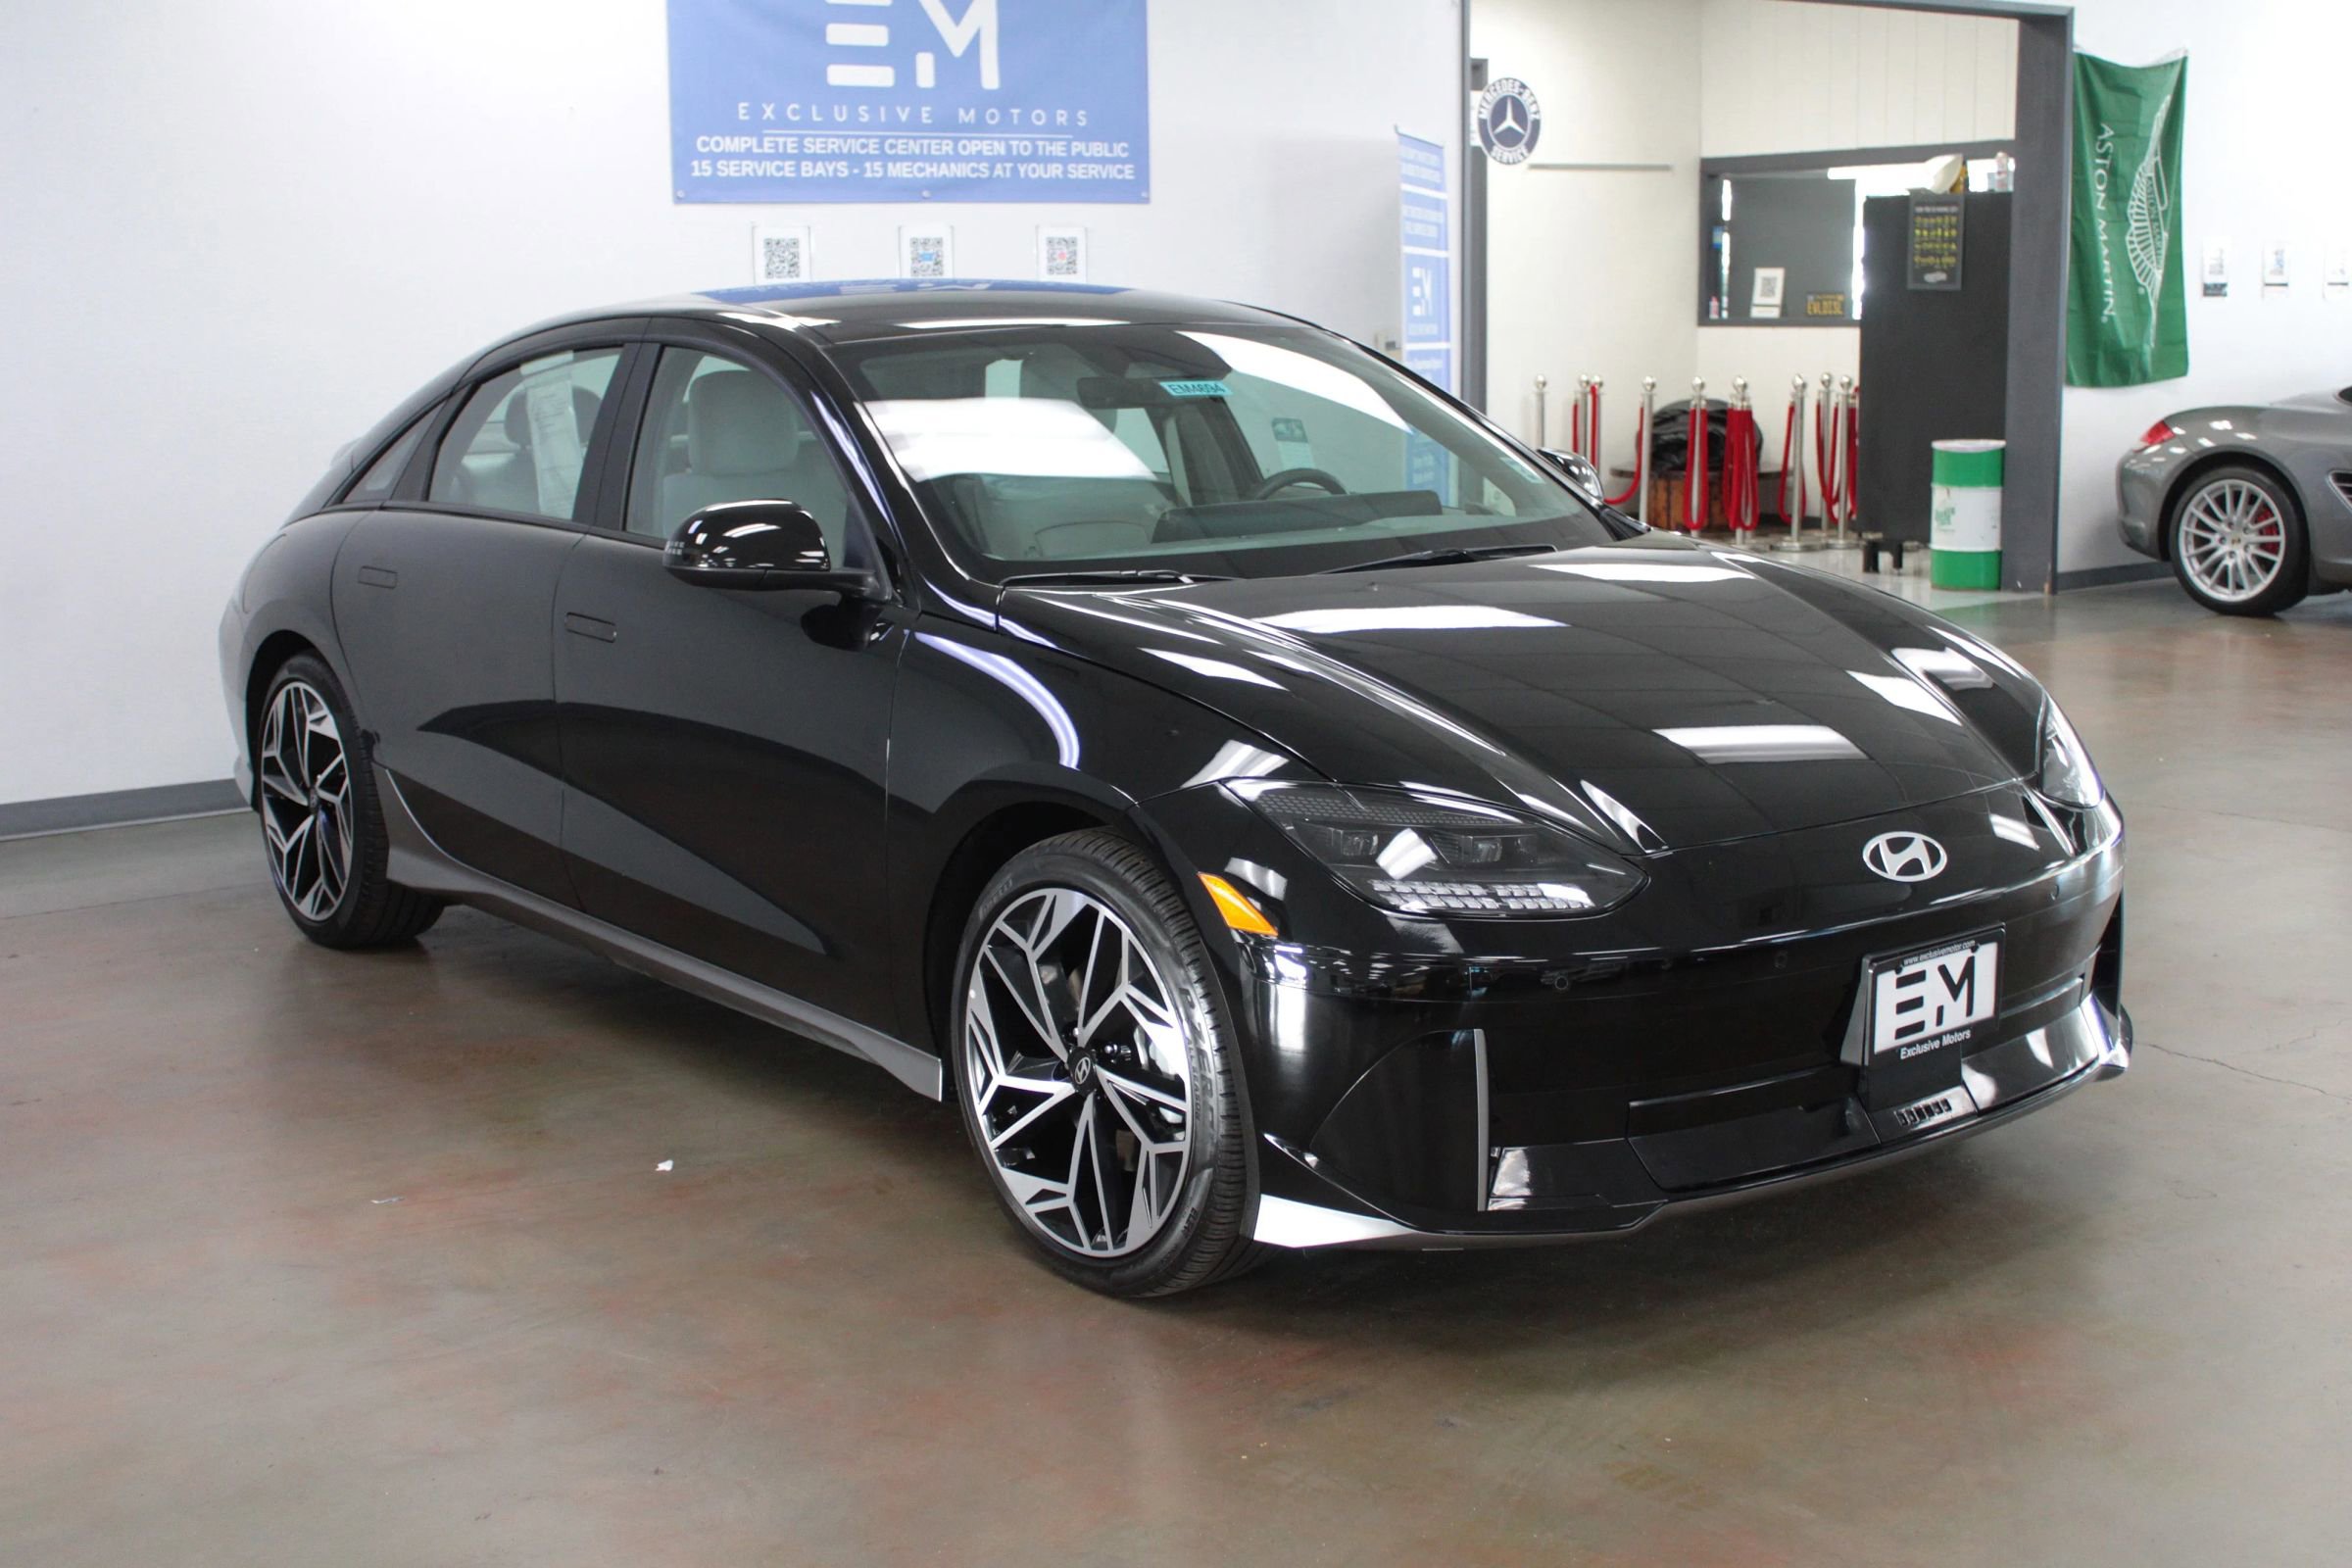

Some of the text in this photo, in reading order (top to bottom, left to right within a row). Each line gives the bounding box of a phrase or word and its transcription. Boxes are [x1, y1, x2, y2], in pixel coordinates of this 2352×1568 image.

[825, 0, 1001, 90] EM
[1478, 78, 1541, 120] MERCEDES-BENZ
[737, 102, 1088, 127] EXCLUSIVE MOTORS
[696, 135, 1130, 158] COMPLETE SERVICE CENTER OPEN TO THE PUBLIC
[1491, 144, 1529, 165] SERVICE
[691, 160, 712, 177] 15
[716, 160, 797, 177] SERVICE
[800, 161, 849, 177] BAYS
[864, 162, 884, 177] 15
[887, 162, 990, 178] MECHANICS
[993, 163, 1013, 178] AT
[1017, 163, 1063, 178] YOUR
[1067, 164, 1135, 179] SERVICE
[2094, 122, 2117, 316] ASTON MARTIN
[1894, 956, 1975, 1040] EM
[1899, 1030, 1972, 1060] Exclusive Motors
